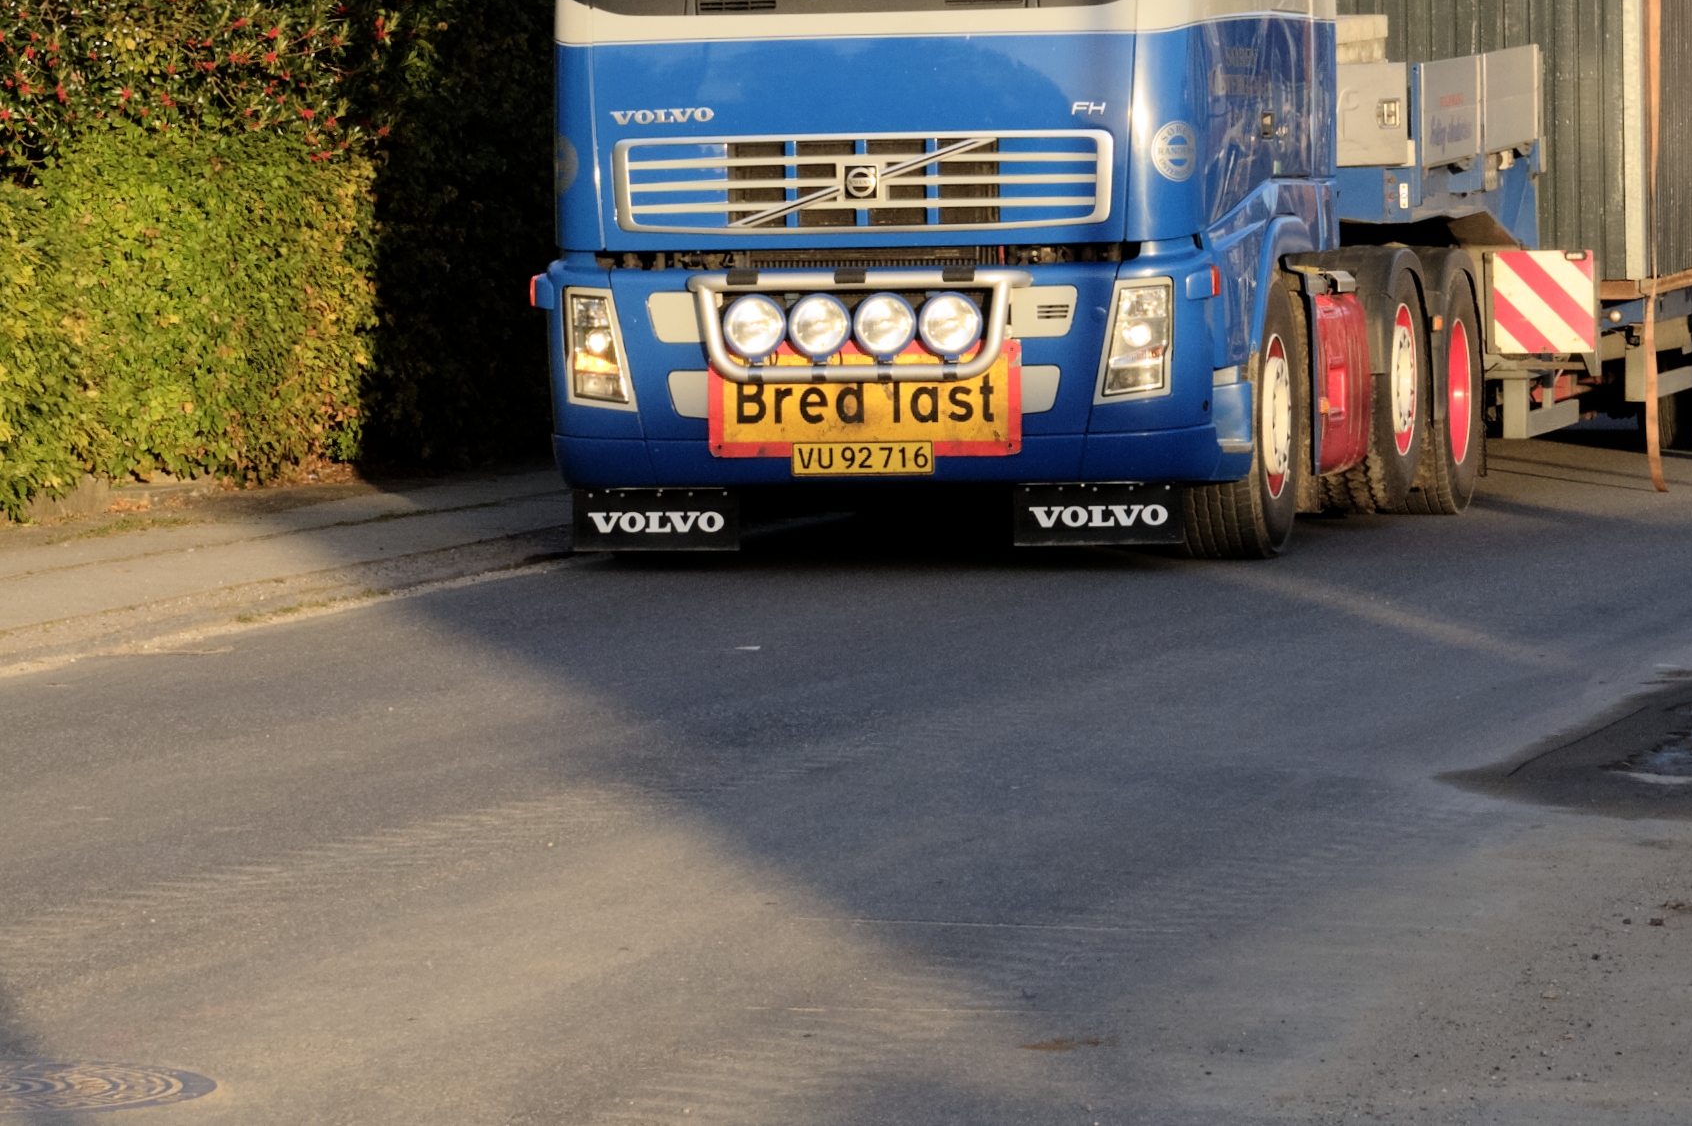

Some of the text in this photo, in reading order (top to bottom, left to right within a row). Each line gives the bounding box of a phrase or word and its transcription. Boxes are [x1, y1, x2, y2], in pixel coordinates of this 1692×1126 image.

[610, 107, 714, 125] VOLVO
[1071, 101, 1107, 116] FH
[736, 373, 996, 424] Bred last
[797, 445, 929, 470] VU 92 716
[587, 511, 725, 534] VOLVO
[1028, 503, 1169, 529] VOLVO
